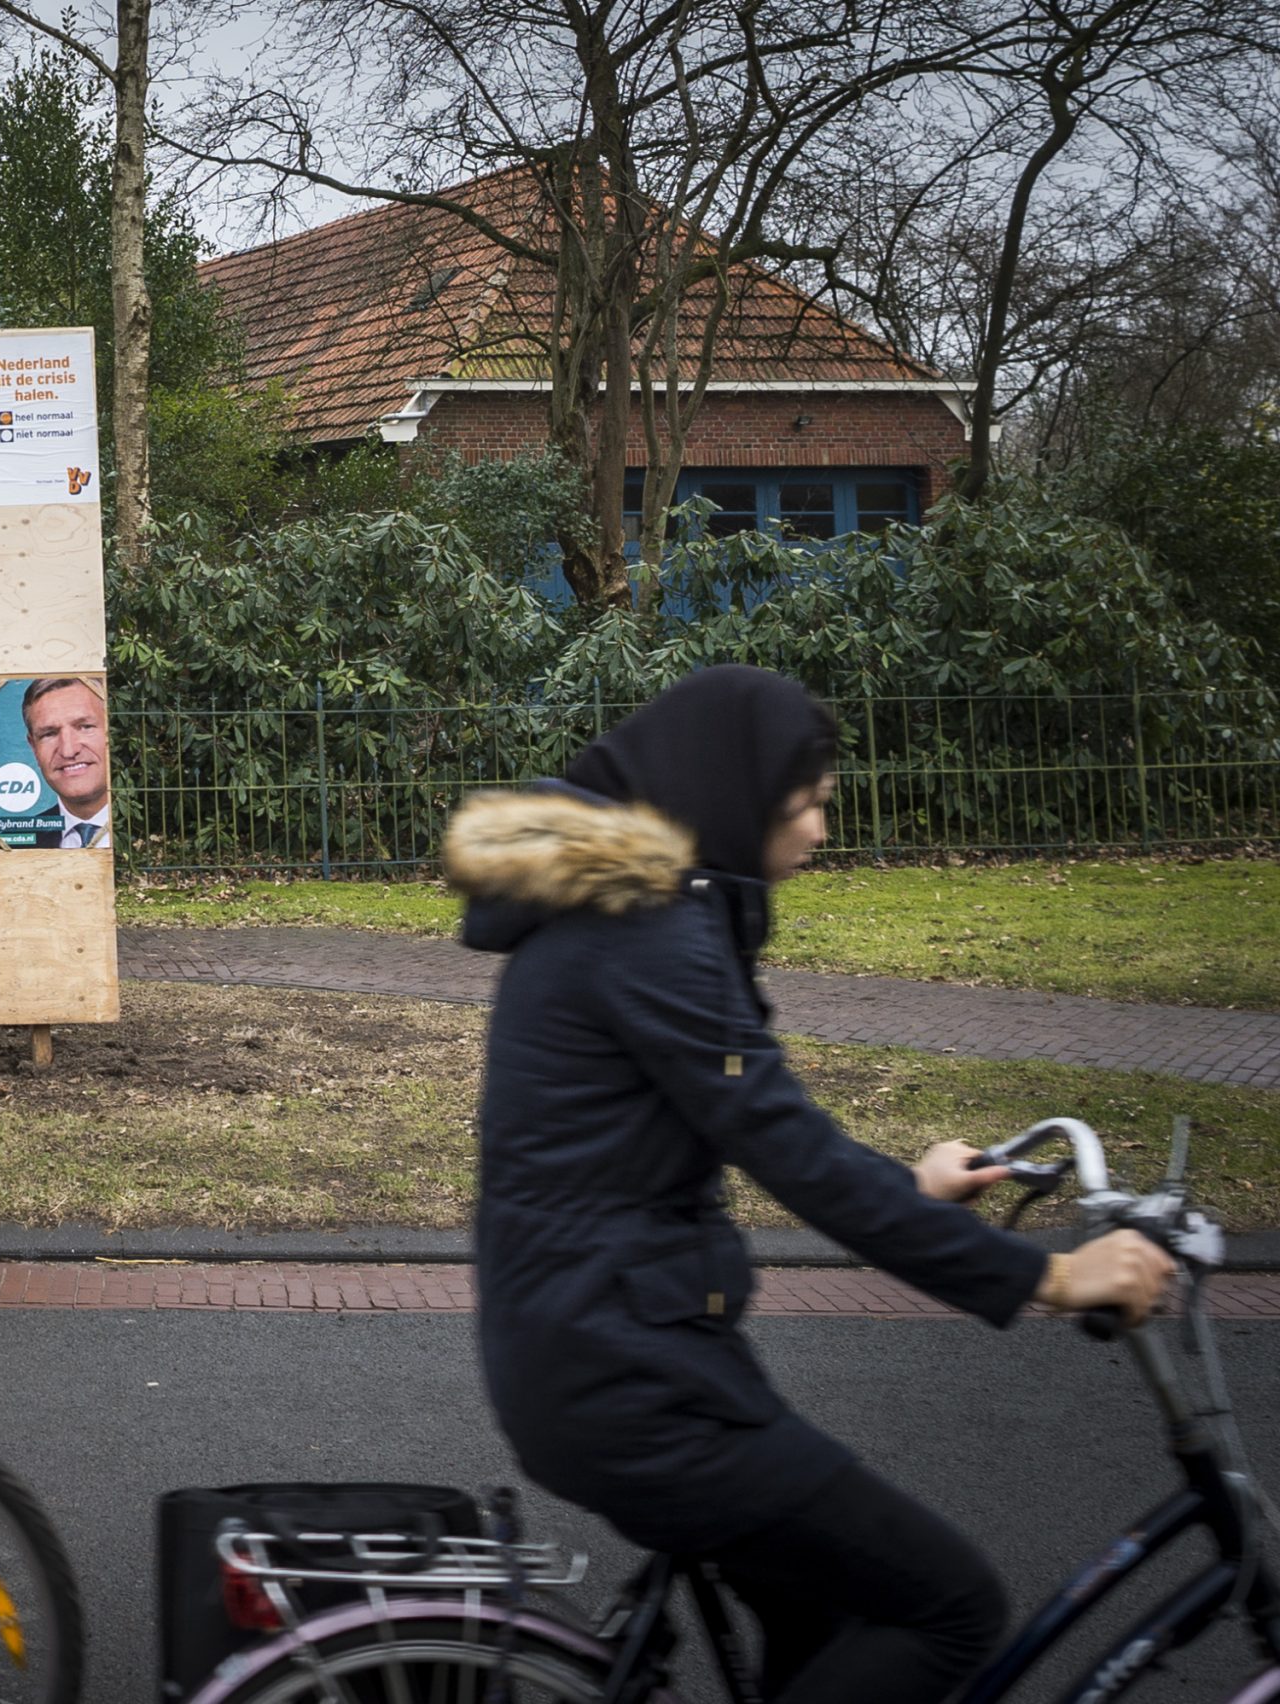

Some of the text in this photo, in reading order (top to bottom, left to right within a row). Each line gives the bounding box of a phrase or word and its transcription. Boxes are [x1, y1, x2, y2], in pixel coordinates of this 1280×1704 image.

[16, 374, 33, 386] de
[37, 371, 76, 385] crisis
[15, 389, 59, 401] halen.
[15, 411, 74, 421] heel normaal
[16, 429, 74, 438] niet normaal
[36, 818, 62, 828] Buma
